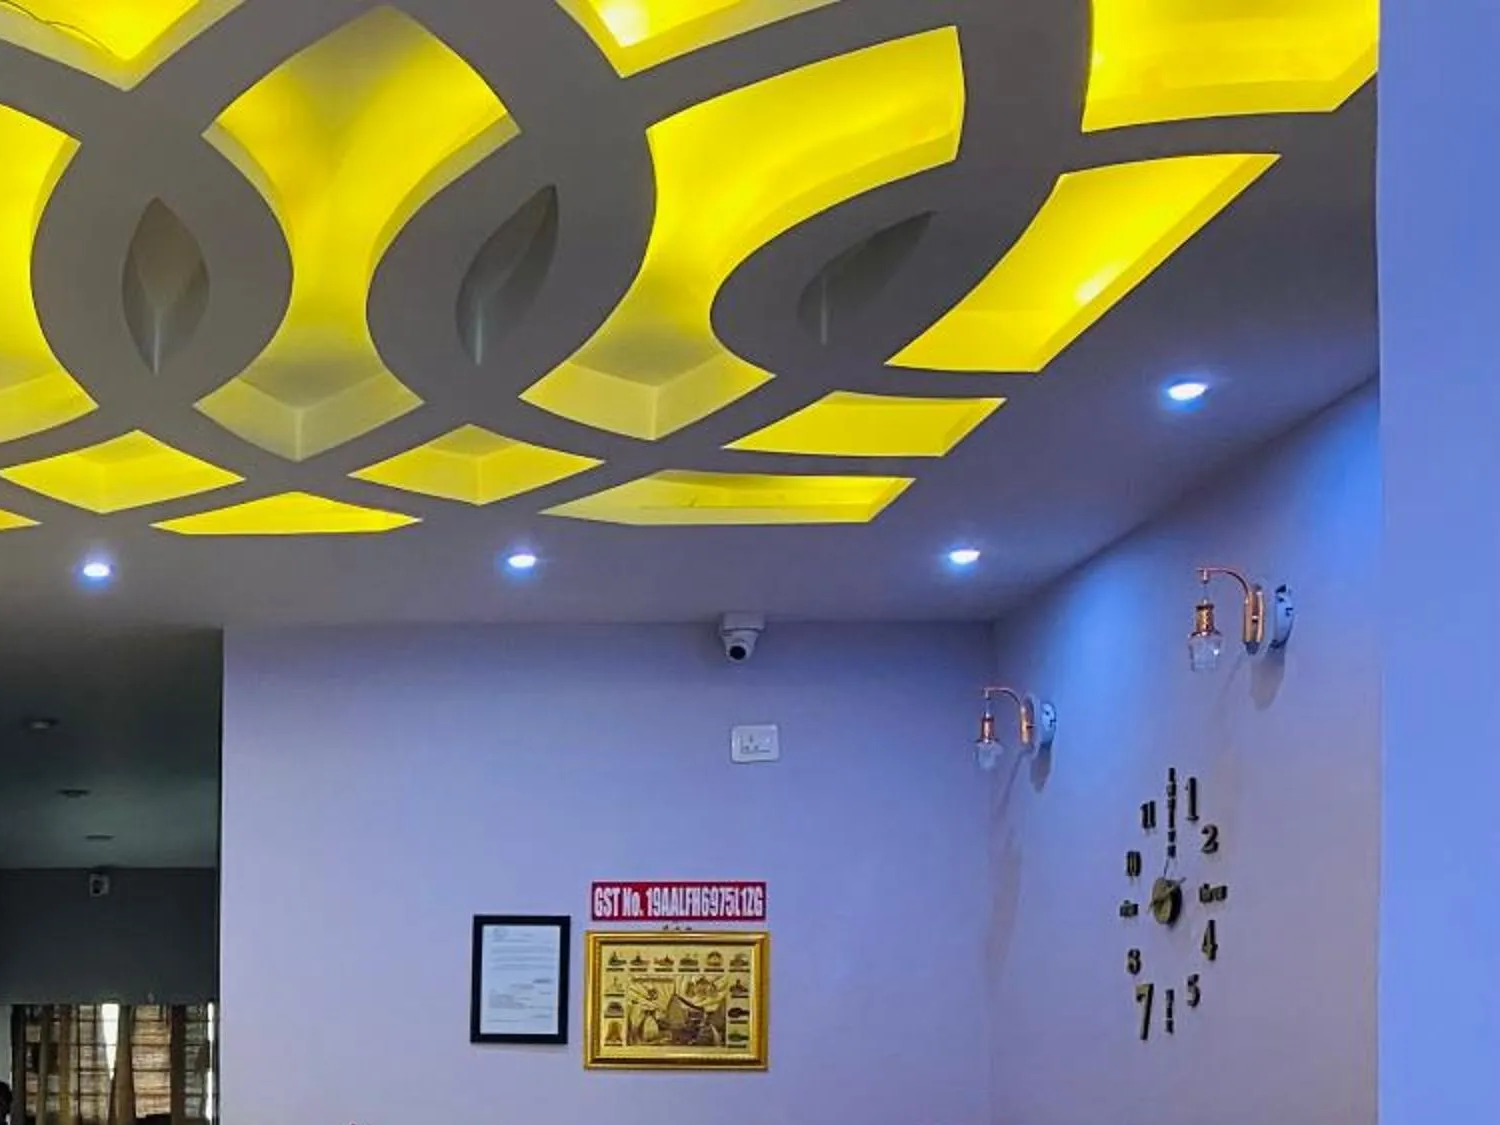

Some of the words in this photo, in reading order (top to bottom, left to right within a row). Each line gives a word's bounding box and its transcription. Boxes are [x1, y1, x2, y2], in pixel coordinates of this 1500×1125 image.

[1201, 824, 1219, 854] 2
[594, 886, 621, 917] GST
[622, 886, 643, 917] No.
[1201, 920, 1218, 961] 4
[1187, 974, 1201, 1008] 5
[1136, 983, 1154, 1040] 7
